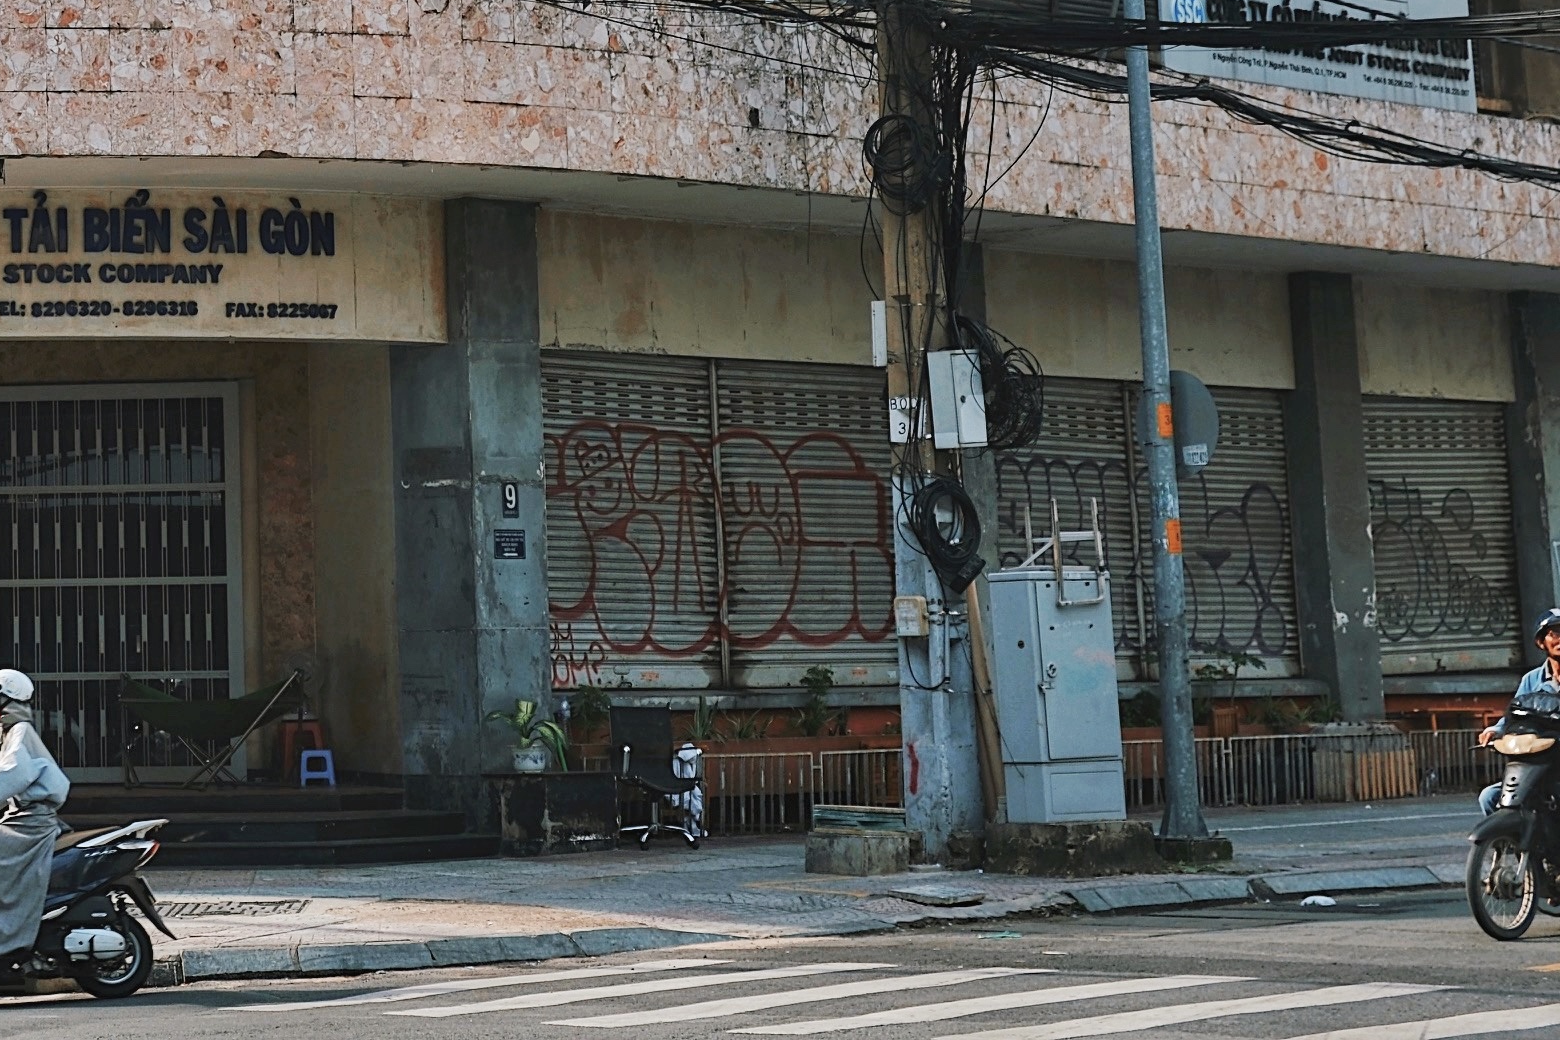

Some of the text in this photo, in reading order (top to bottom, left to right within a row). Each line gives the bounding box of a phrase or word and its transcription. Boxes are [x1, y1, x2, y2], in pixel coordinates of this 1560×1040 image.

[3, 190, 69, 254] TẢI
[84, 189, 171, 254] BIỂN
[183, 196, 247, 255] SÀI
[259, 198, 336, 257] GÒN
[3, 263, 91, 285] STOCK
[99, 263, 224, 285] COMPANY
[225, 302, 265, 318] FAX:
[898, 422, 907, 435] 3
[505, 484, 517, 509] 9
